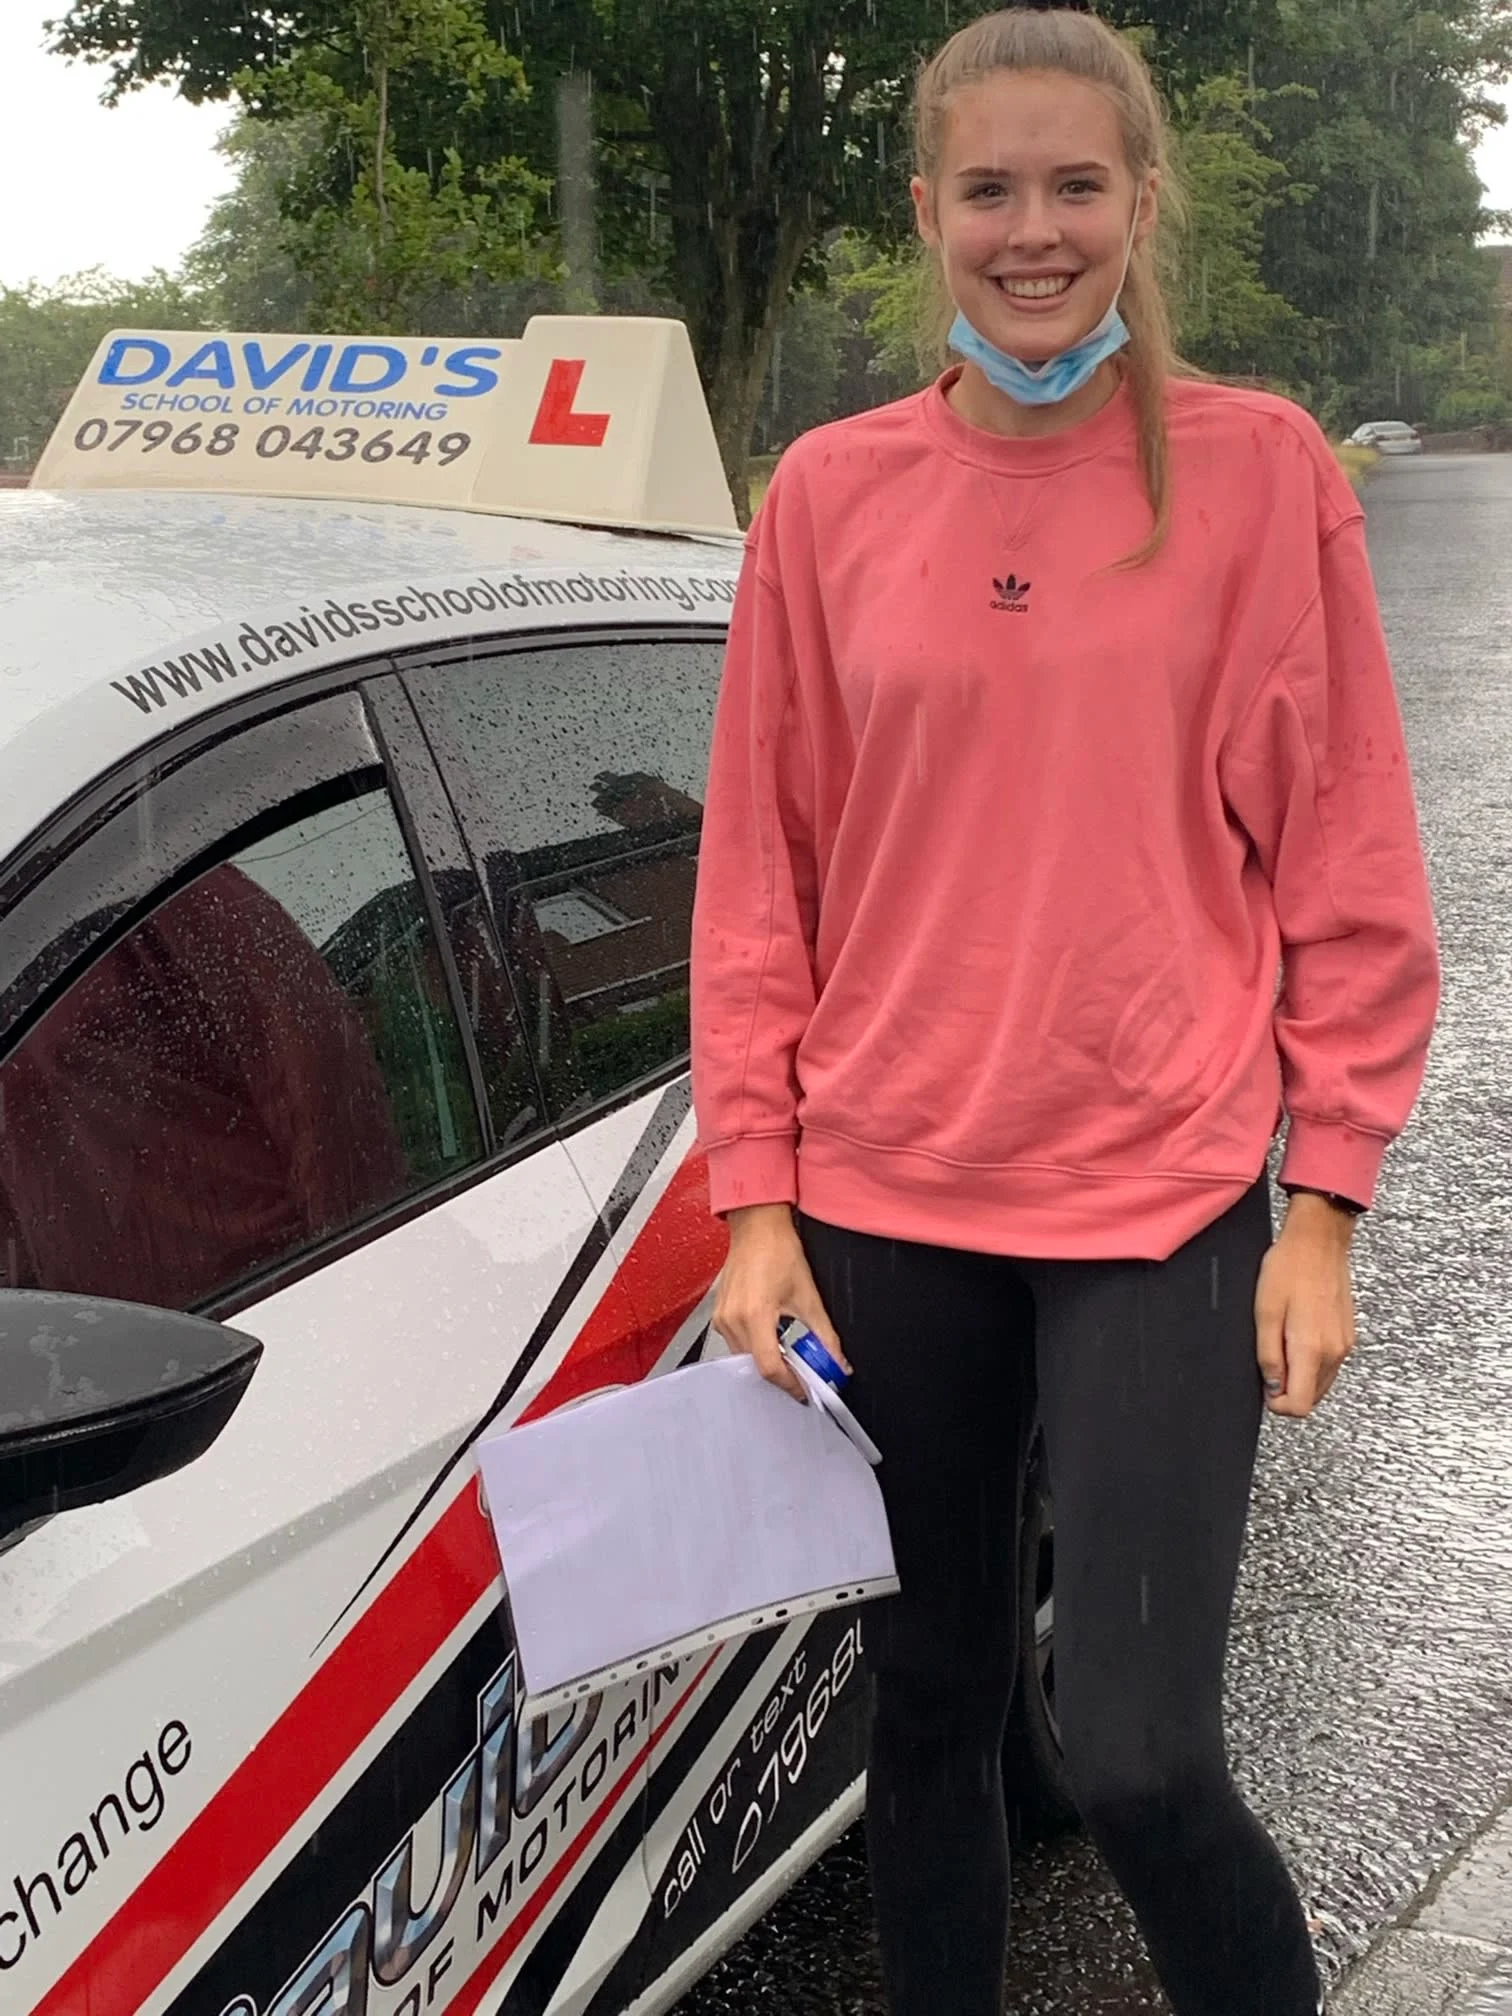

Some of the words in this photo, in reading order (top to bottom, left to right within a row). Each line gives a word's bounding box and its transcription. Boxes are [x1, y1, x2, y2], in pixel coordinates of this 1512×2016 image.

[97, 338, 502, 398] DAVID'S
[120, 392, 233, 415] SCHOOL
[243, 396, 282, 415] OF
[295, 397, 449, 422] MOTORING
[528, 358, 611, 447] L
[73, 418, 240, 457] 07968
[255, 424, 471, 466] 043649
[989, 600, 1028, 612] adidas
[477, 1654, 693, 1942] MOTORIN
[664, 1817, 706, 1919] call
[710, 1757, 741, 1825] or
[750, 1650, 807, 1753] text
